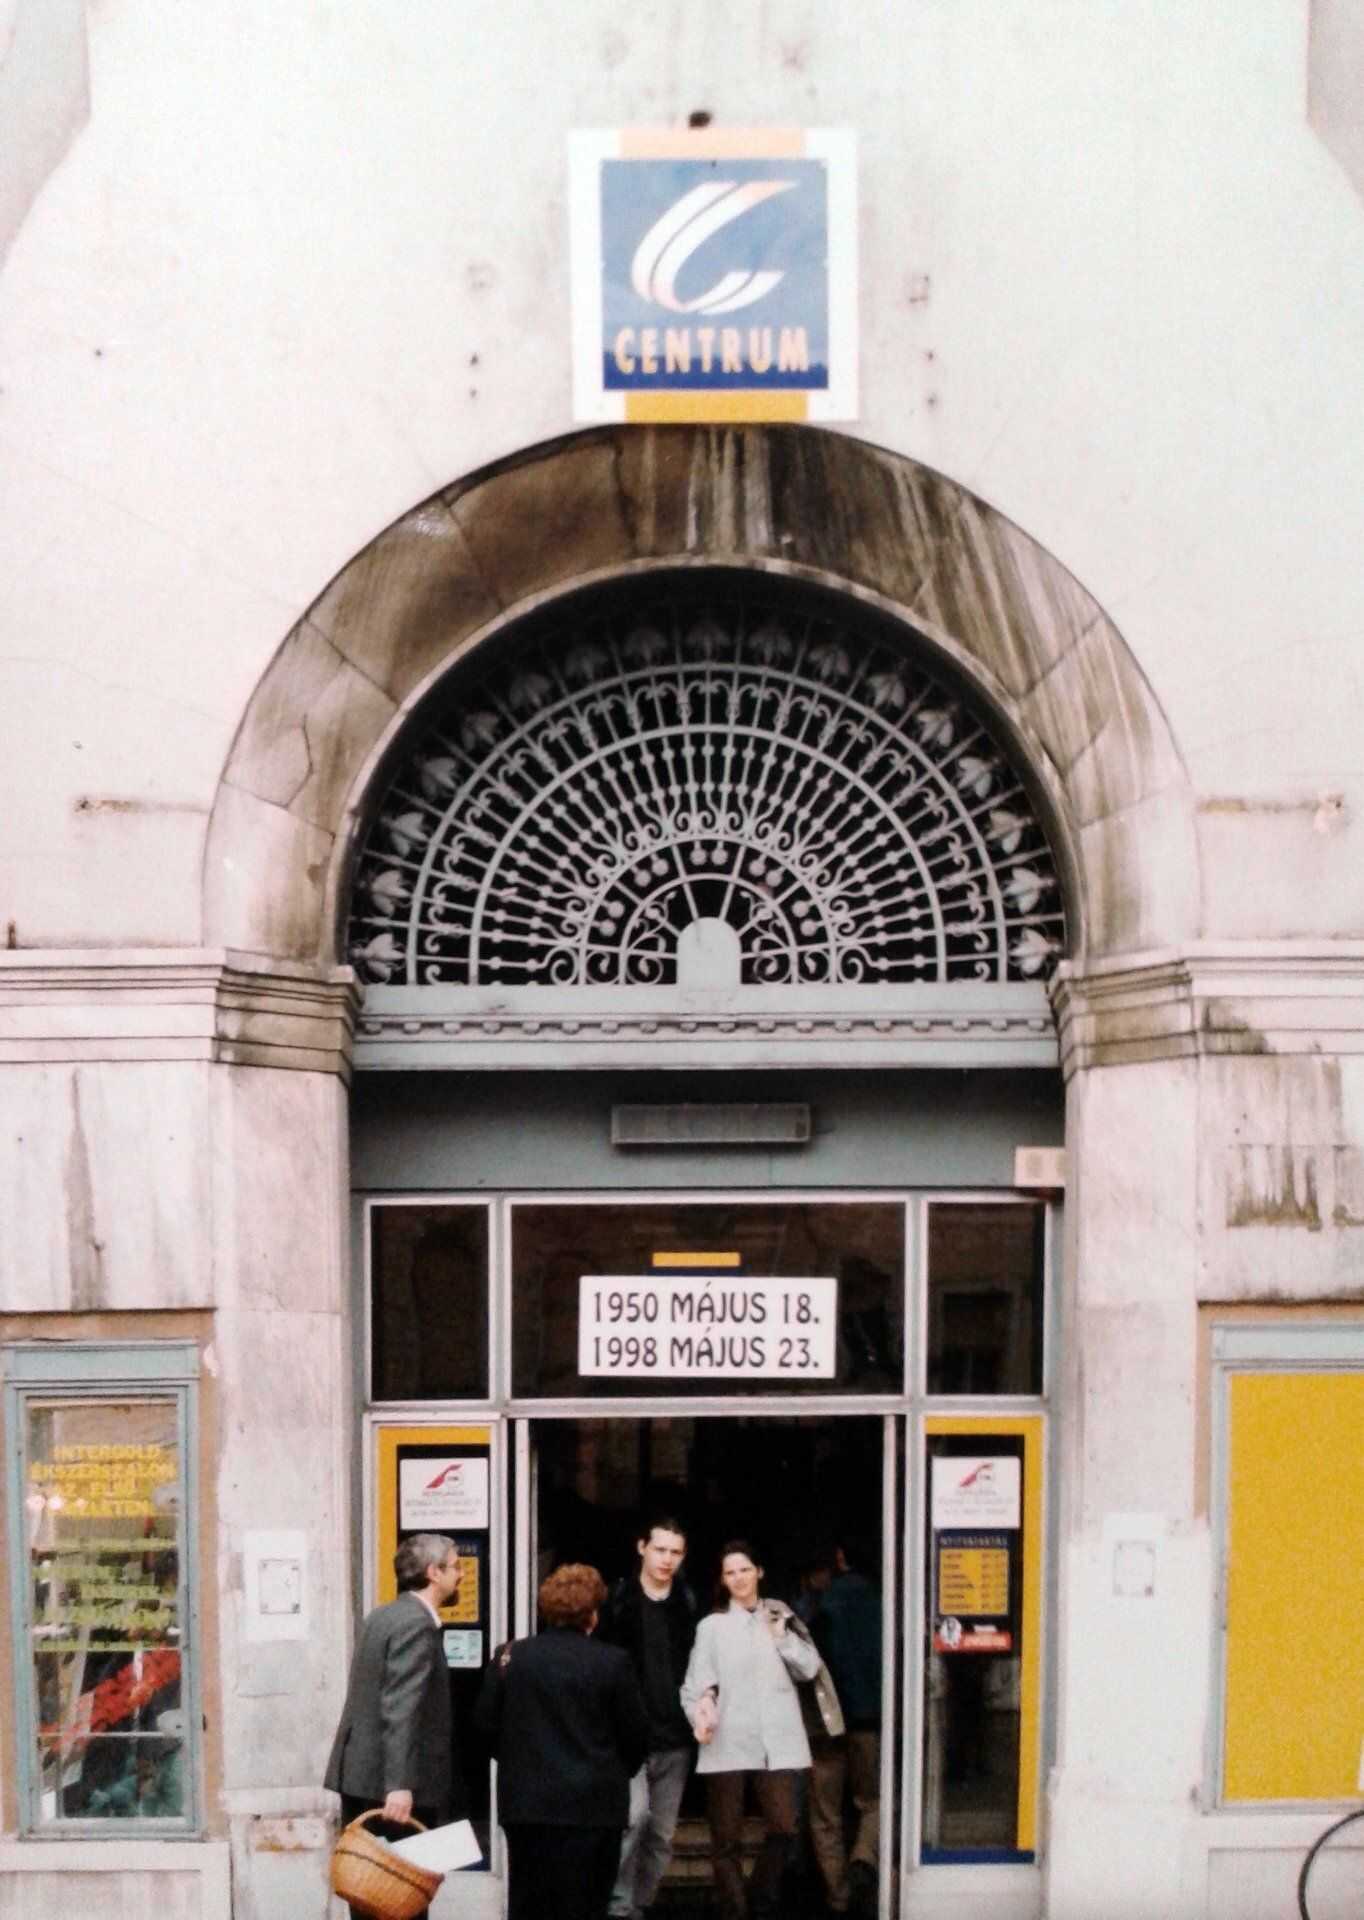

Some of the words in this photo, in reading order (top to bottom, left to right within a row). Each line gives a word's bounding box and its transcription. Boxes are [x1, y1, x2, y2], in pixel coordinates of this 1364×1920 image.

[614, 326, 809, 374] CENTRUM
[594, 1292, 659, 1323] 1950
[670, 1281, 767, 1324] MÁJUS
[782, 1293, 820, 1324] 18.
[594, 1336, 658, 1367] 1998
[669, 1326, 766, 1368] MÁJUS
[777, 1337, 820, 1368] 23.
